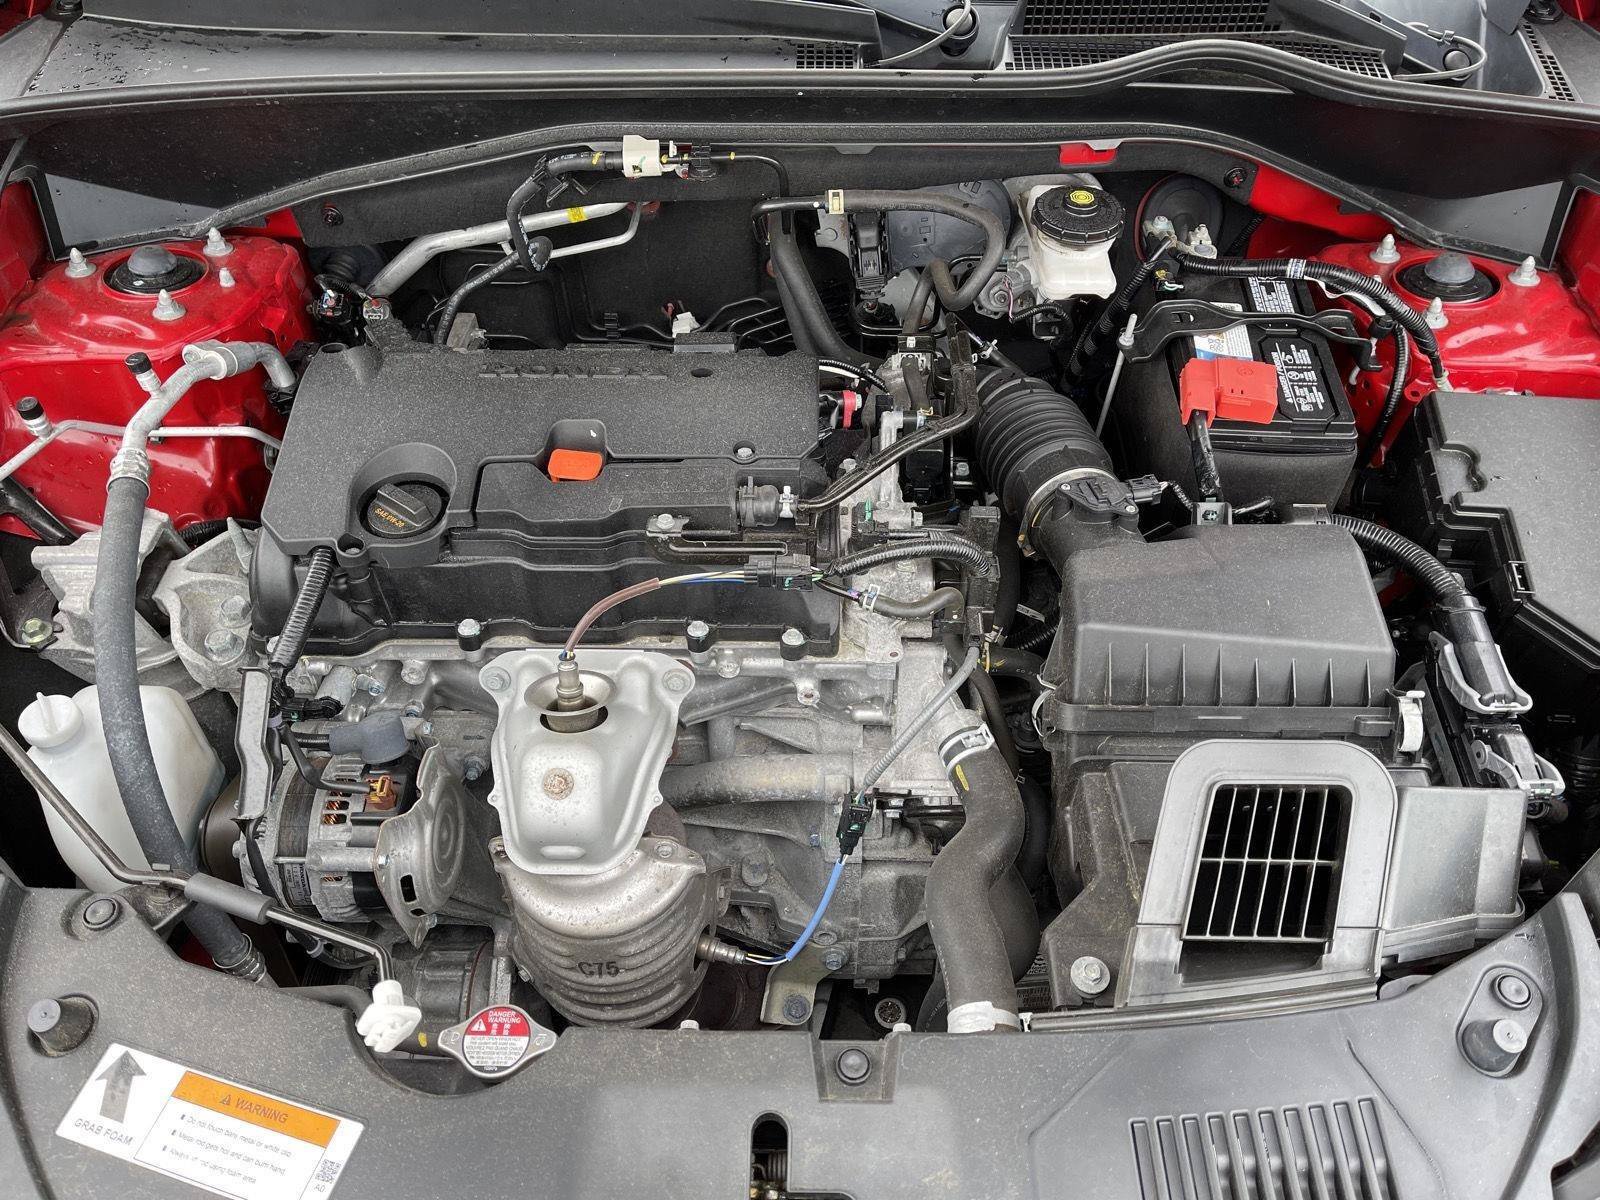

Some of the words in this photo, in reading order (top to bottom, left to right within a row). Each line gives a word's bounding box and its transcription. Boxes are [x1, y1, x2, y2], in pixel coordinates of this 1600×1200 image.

[374, 507, 389, 518] SAE
[488, 1010, 516, 1018] DANGER
[235, 1097, 289, 1124] WARNING
[74, 1118, 103, 1135] GRAB
[103, 1127, 133, 1146] FOAM
